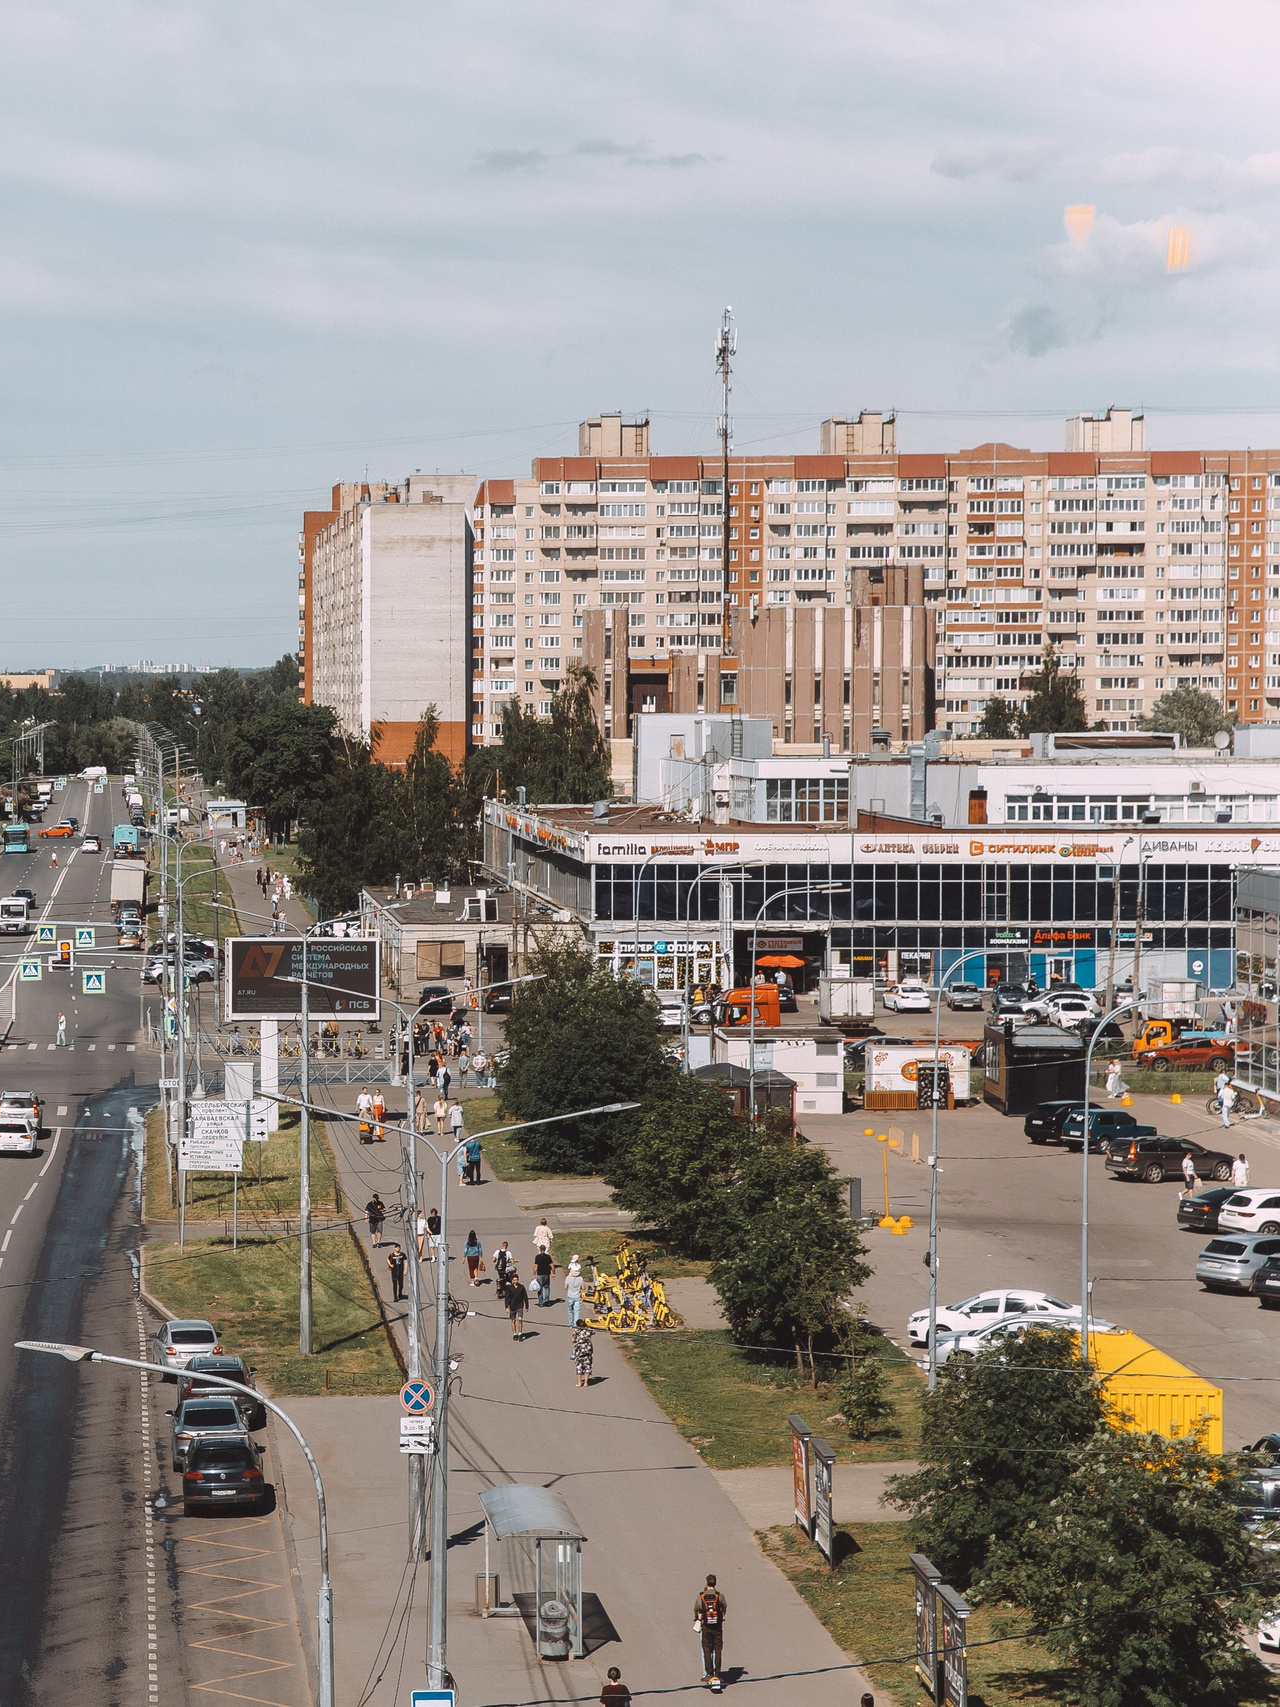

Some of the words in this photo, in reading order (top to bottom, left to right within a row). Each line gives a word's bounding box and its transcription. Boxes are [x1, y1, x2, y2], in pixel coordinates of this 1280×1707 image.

[597, 843, 647, 855] familia
[878, 843, 916, 854] АПТЕКА
[922, 843, 960, 854] ОЗЕРКИ
[988, 844, 1057, 854] СИТИЛИНК
[1141, 841, 1198, 852] ДИВАНЫ
[1034, 930, 1066, 941] Альфа
[1067, 931, 1091, 940] Банк
[311, 944, 368, 952] РОССИЙСКАЯ
[620, 943, 655, 953] ПИТЕР
[667, 944, 710, 953] ОПТИКА
[901, 951, 931, 960] ПЕКАРНЯ
[349, 1000, 370, 1009] ПСБ
